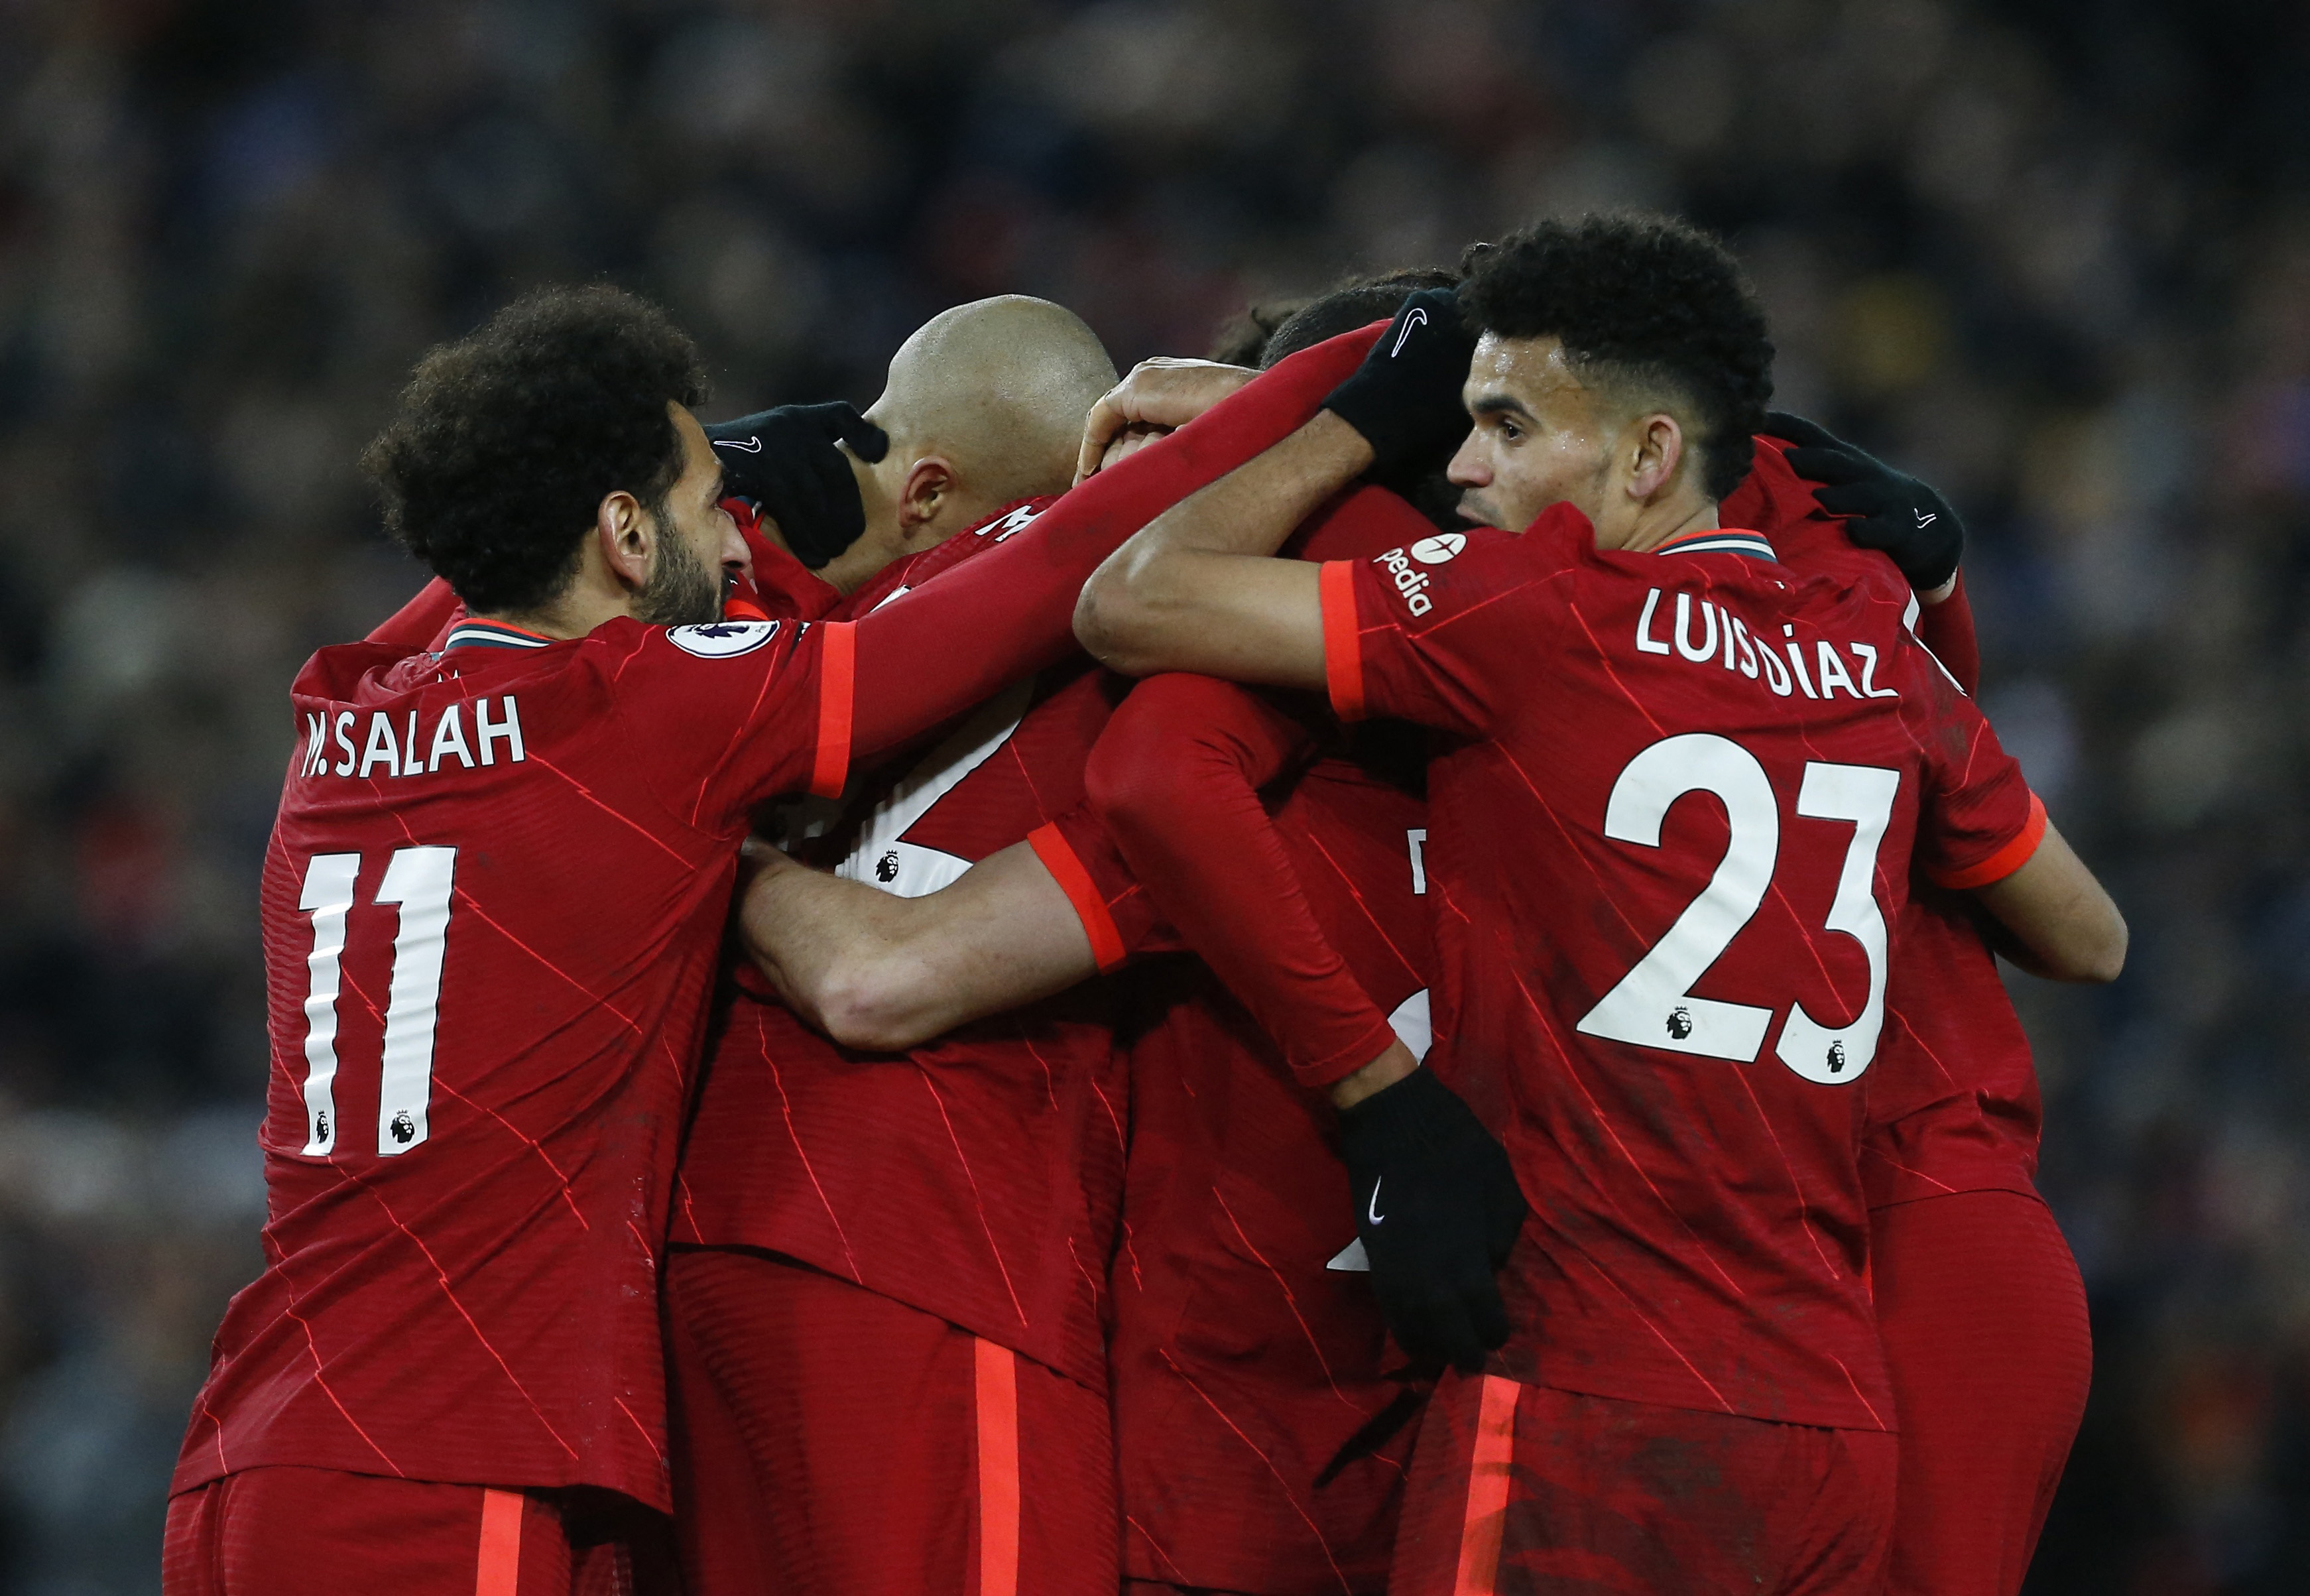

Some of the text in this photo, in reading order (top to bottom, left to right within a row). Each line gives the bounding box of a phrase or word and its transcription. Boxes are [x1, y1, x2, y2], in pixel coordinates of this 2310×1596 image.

[1635, 587, 1760, 680] LUIS
[300, 695, 526, 778] M.SALAH
[299, 844, 458, 1156] 11
[1576, 732, 1901, 1085] 23
